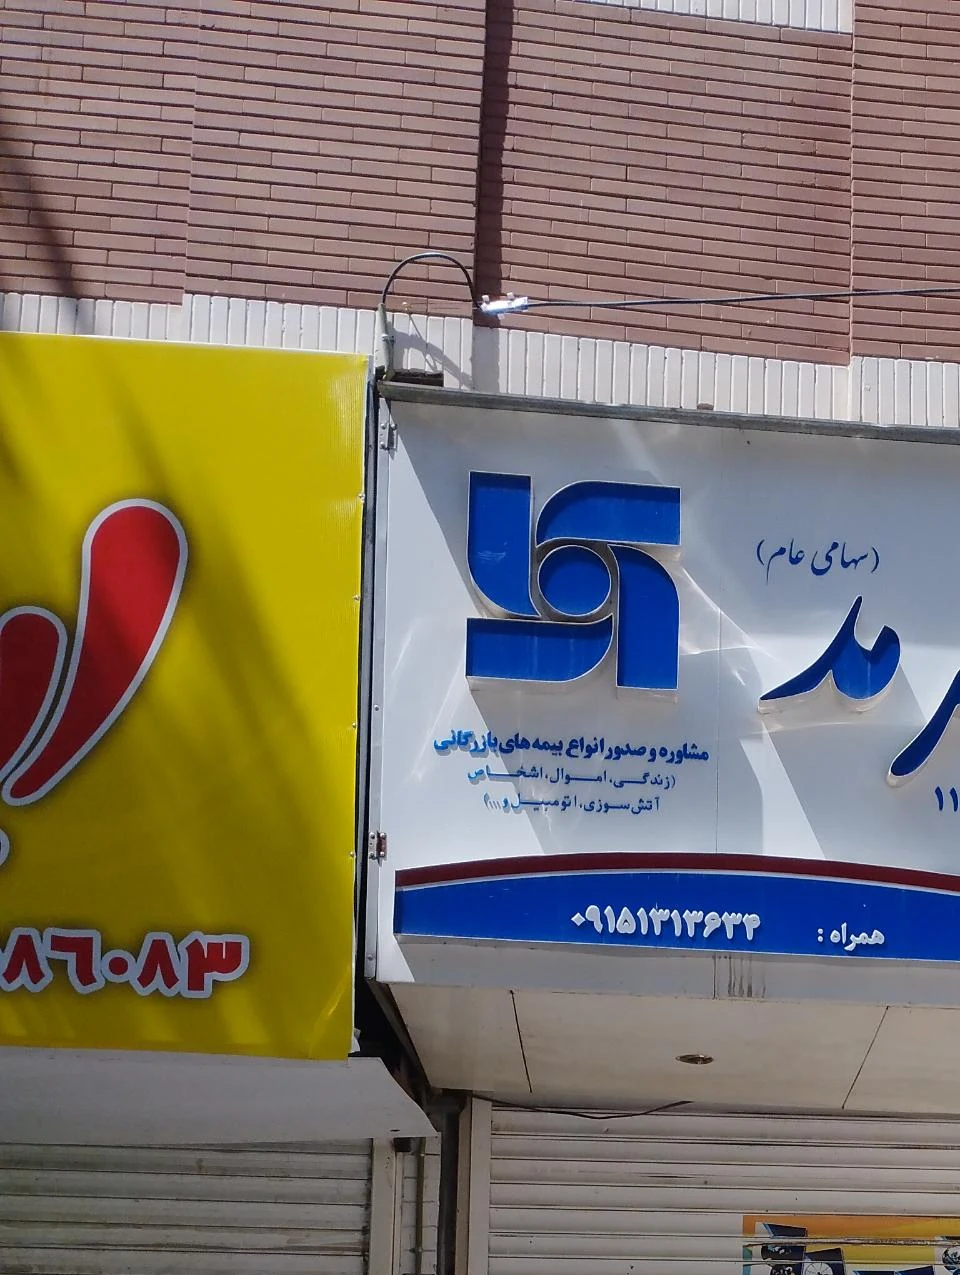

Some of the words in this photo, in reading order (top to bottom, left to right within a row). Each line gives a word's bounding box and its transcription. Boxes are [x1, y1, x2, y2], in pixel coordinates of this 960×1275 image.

[433, 729, 498, 754] بازرگانی
[499, 733, 531, 755] های
[531, 739, 563, 757] بیمه
[566, 736, 605, 759] انواع
[604, 744, 647, 762] صدور
[648, 747, 657, 763] و
[658, 742, 709, 765] مشاوره
[467, 764, 544, 783] اشخاص
[630, 796, 660, 814] آتش
[571, 904, 761, 941] ۰۹۱۵۱۳۱۳۶۳۴
